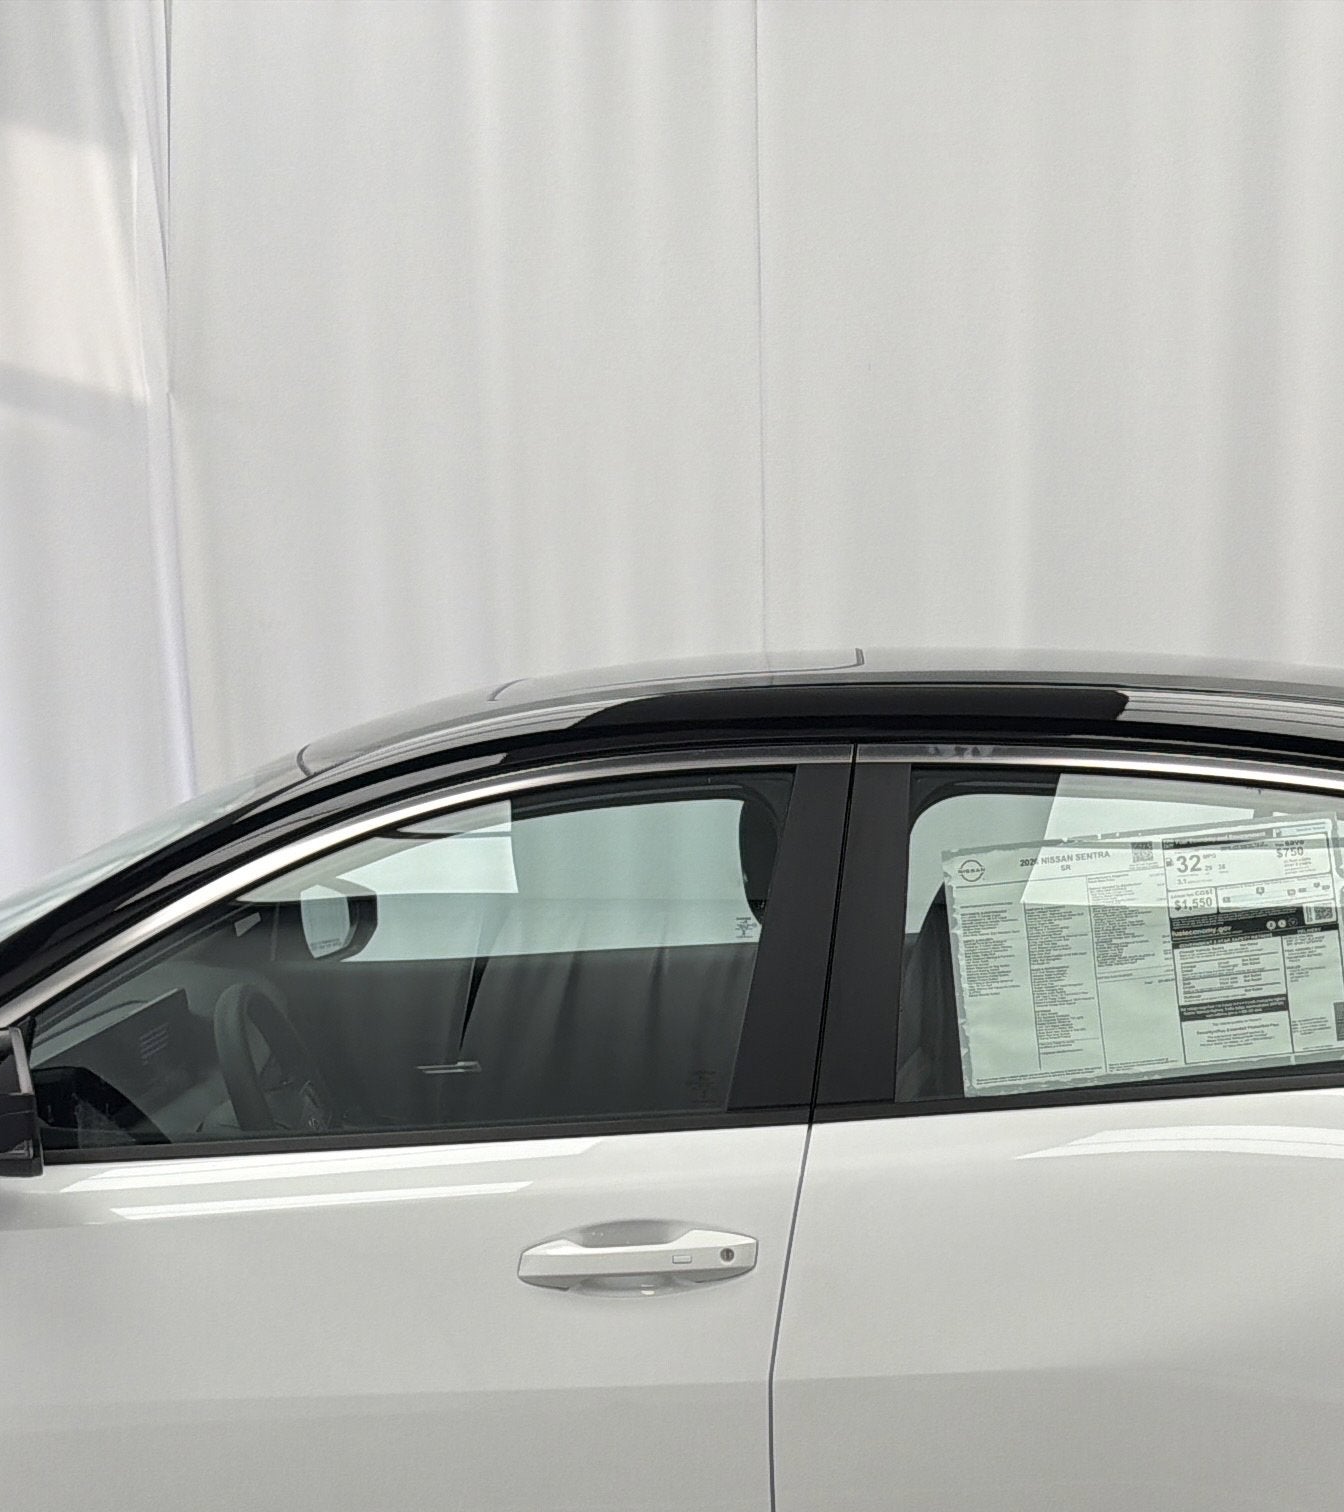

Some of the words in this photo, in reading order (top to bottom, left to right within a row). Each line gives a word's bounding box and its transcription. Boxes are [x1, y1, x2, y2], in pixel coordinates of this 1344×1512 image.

[1041, 854, 1074, 865] NISSAN
[1075, 851, 1111, 862] SENTRA
[1276, 846, 1304, 858] $750
[1176, 854, 1202, 874] 32
[1174, 896, 1213, 911] $1,550
